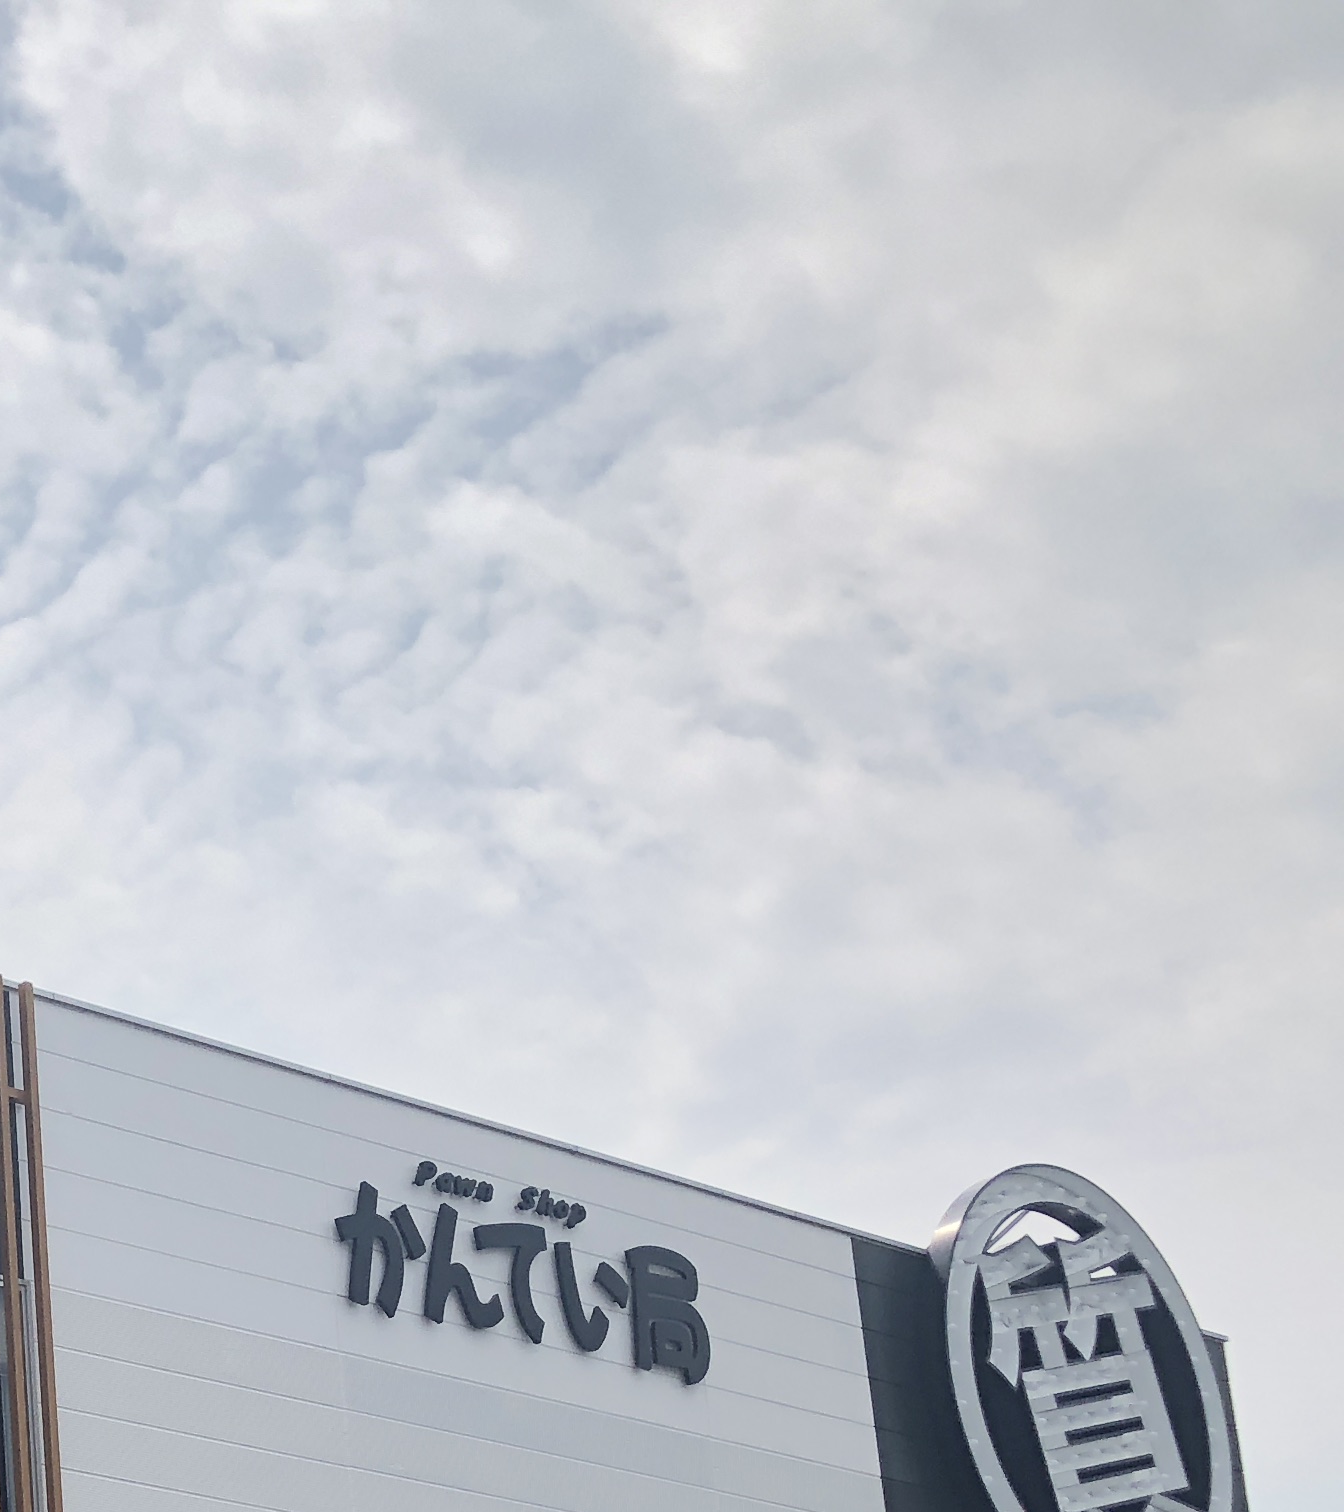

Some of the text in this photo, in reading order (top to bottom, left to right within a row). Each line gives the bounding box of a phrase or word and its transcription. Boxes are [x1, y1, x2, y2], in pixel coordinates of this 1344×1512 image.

[412, 1160, 587, 1230] Pawn Shop
[333, 1180, 711, 1386] かんてい局
